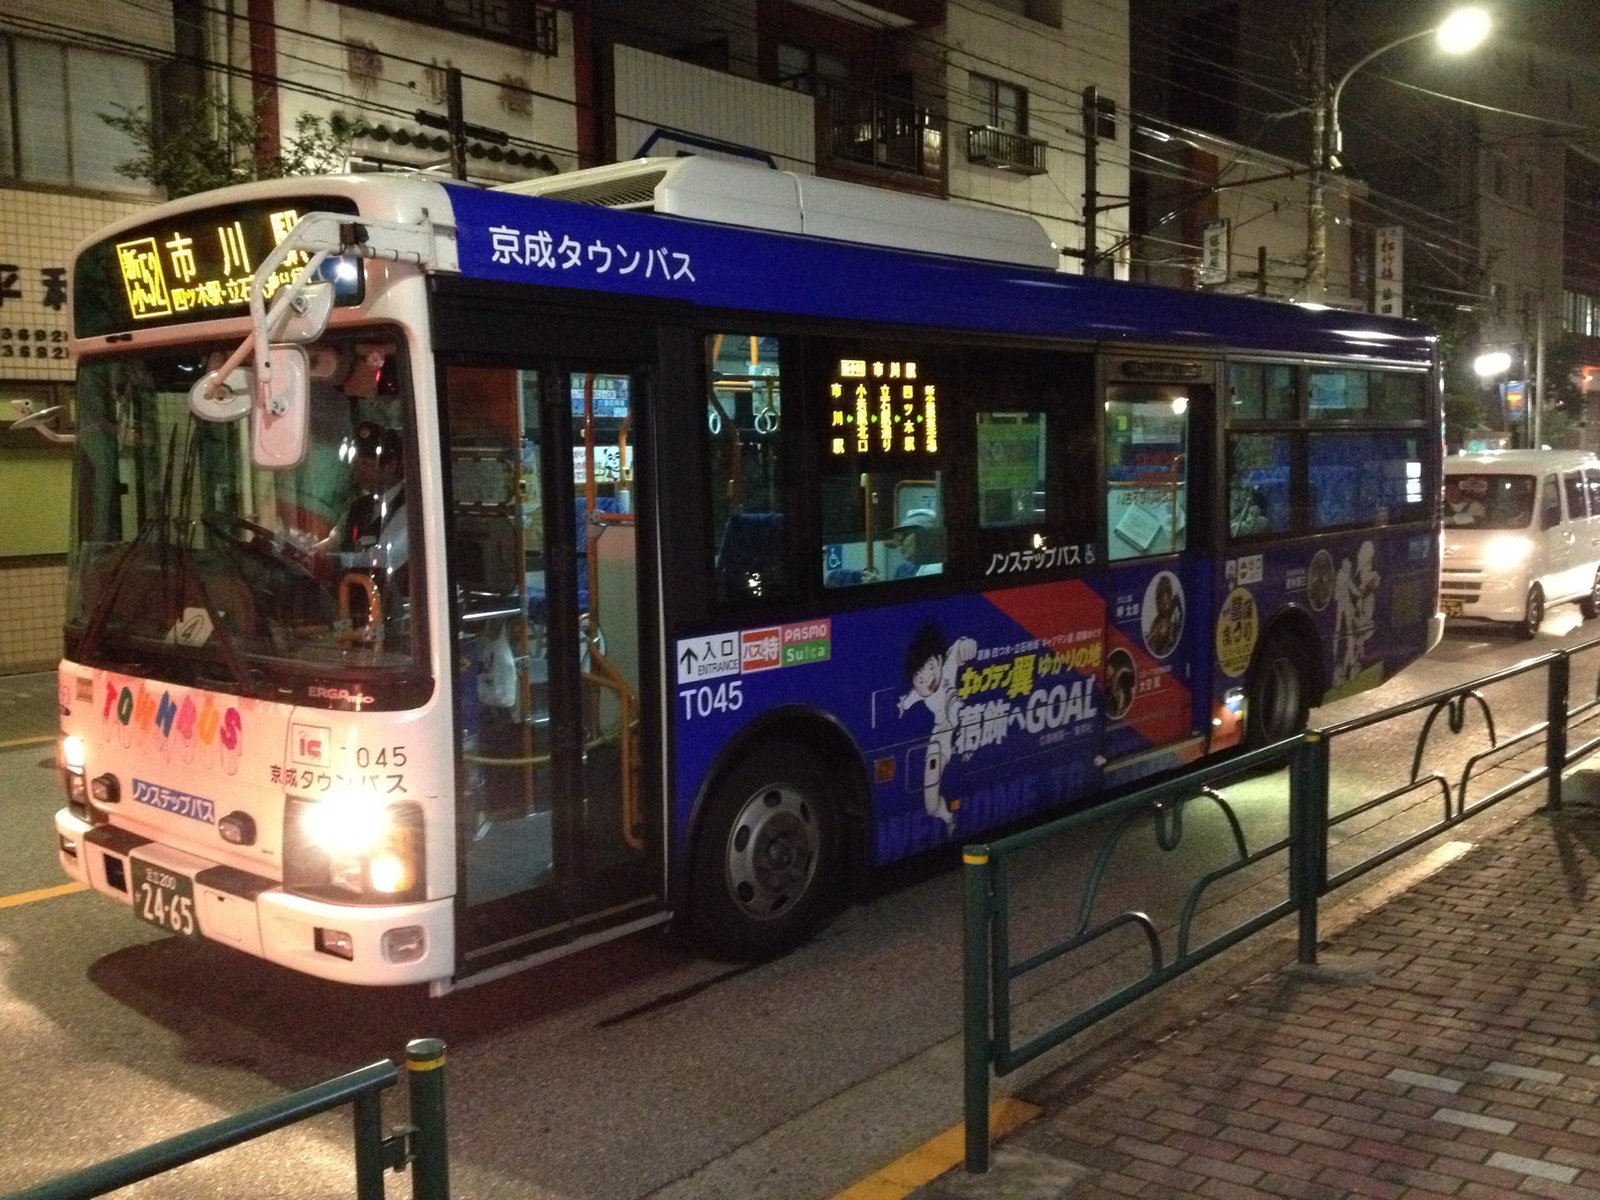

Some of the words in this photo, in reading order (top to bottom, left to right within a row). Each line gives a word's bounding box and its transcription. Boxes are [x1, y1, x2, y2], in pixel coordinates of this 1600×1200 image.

[488, 224, 696, 283] 京成タウンバス
[985, 545, 1082, 576] ノンステップバス
[784, 624, 828, 642] PASMO
[702, 639, 734, 661] 入口
[786, 645, 827, 663] Suica
[697, 658, 739, 677] ENTRANCE
[958, 653, 1037, 700] キャプテン翼
[1037, 641, 1102, 678] ゆかりの地
[679, 680, 744, 721] T045
[340, 745, 408, 769] 045
[269, 763, 408, 794] 京成タウンバス
[133, 779, 217, 824] ノンステップバス
